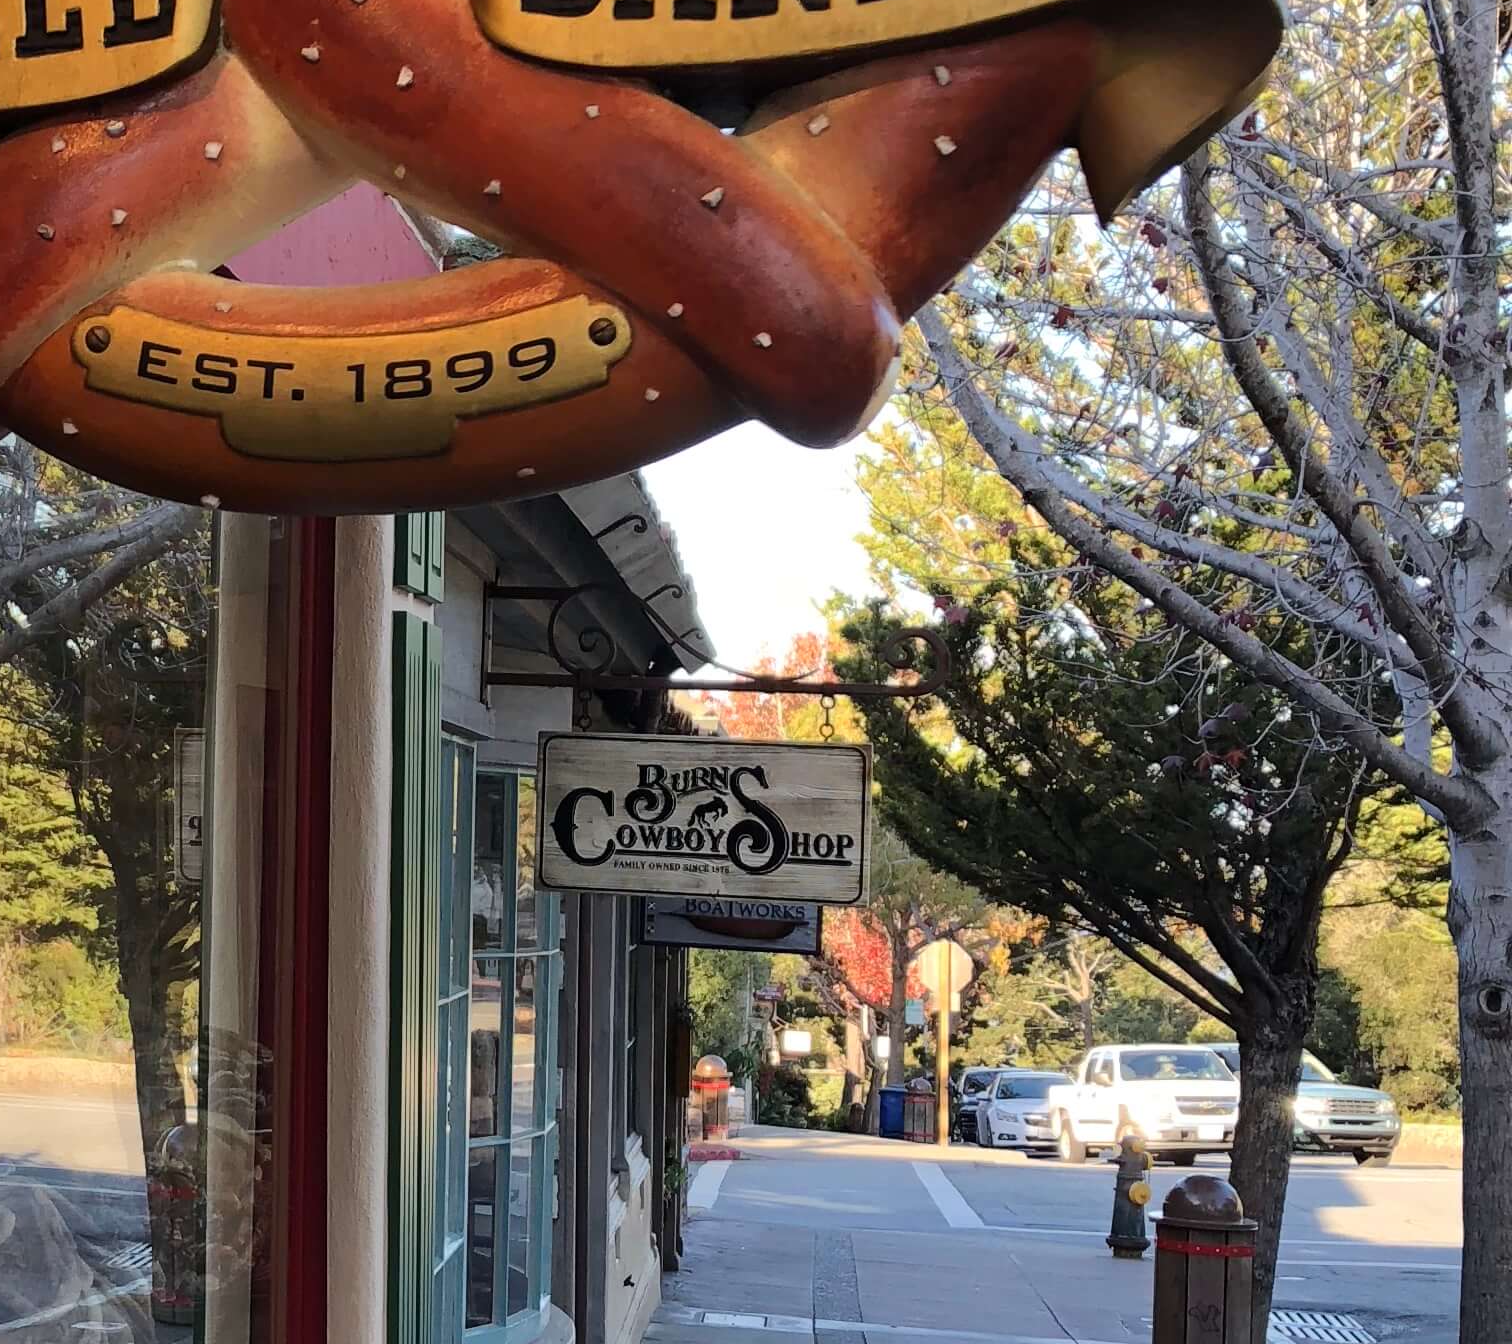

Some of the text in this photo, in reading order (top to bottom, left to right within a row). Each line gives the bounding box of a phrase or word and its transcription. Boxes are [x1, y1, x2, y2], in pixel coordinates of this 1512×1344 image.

[137, 336, 557, 403] EST. 1899
[550, 776, 855, 875] COWBOY SHOP
[613, 859, 647, 871] FAMILY
[648, 861, 681, 872] OWNED
[682, 863, 709, 874] SINCE
